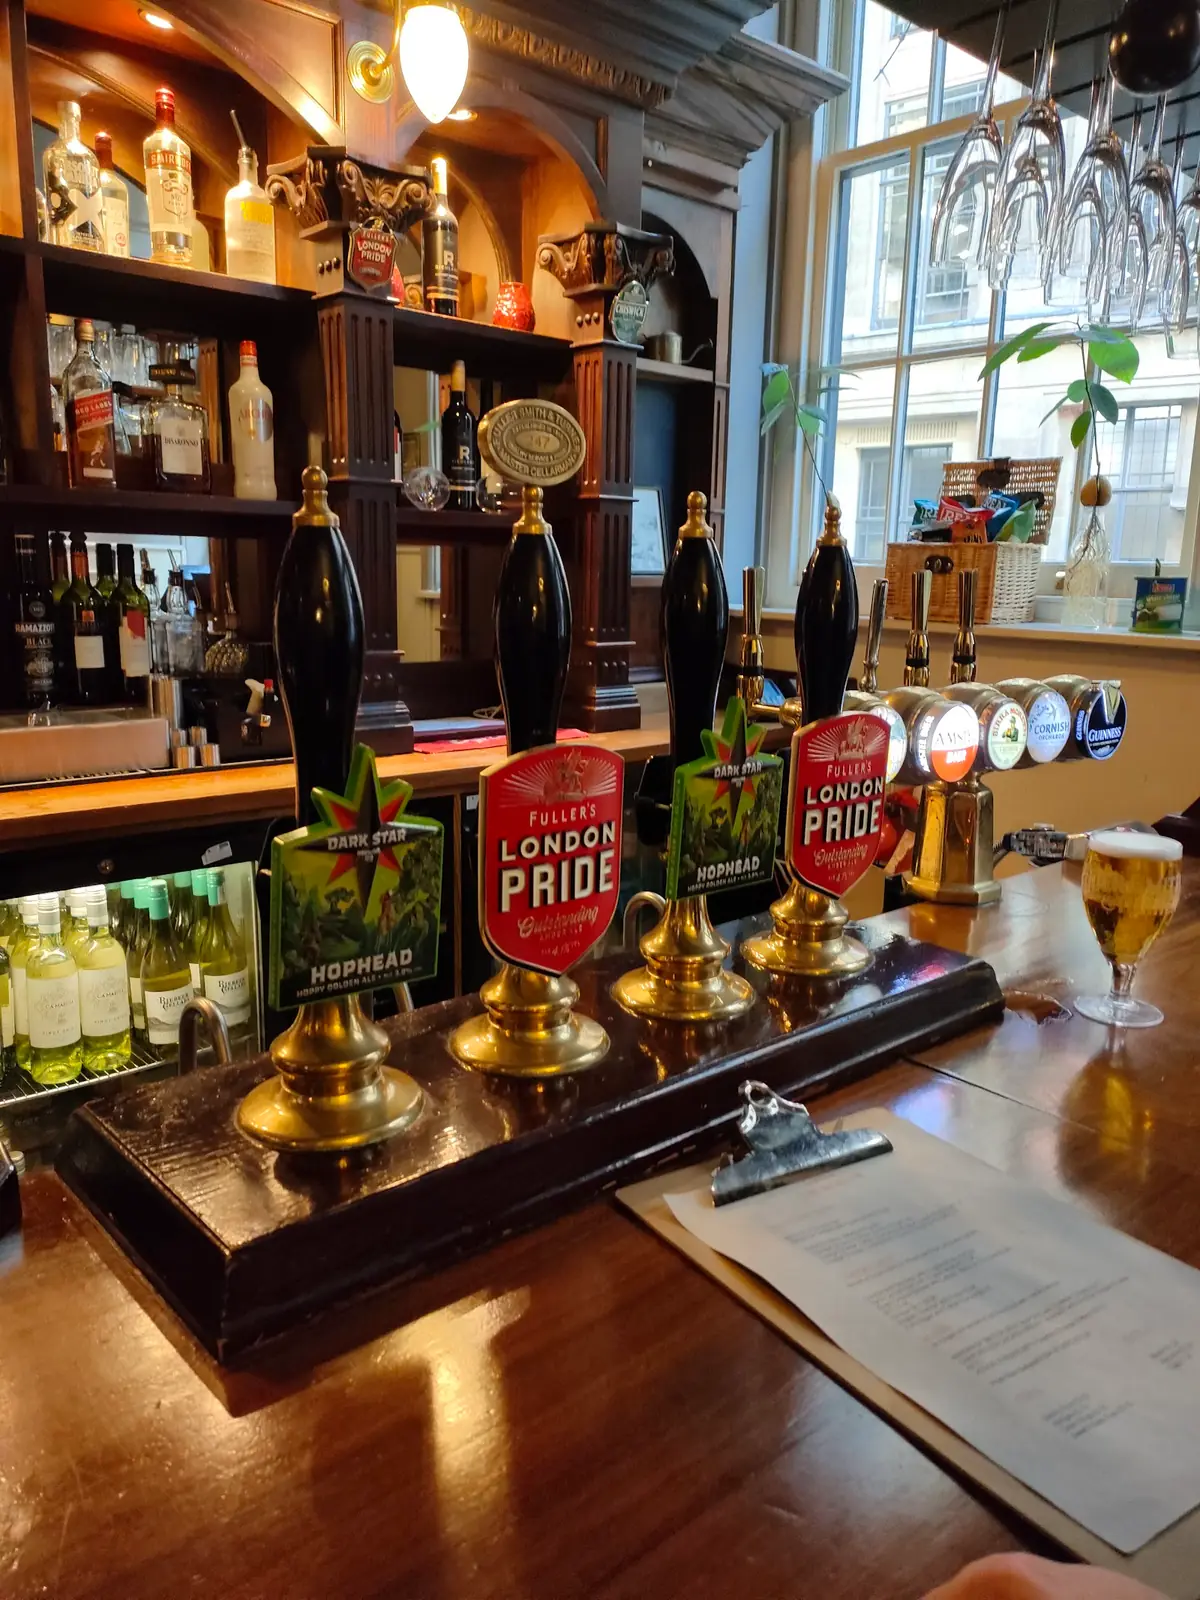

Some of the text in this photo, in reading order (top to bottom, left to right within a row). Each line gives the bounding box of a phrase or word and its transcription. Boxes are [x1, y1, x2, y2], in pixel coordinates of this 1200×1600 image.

[357, 240, 392, 257] LONDON
[361, 250, 386, 263] PRIDE
[616, 303, 644, 317] CHISWICK
[520, 406, 546, 420] SMITH
[163, 436, 199, 447] DISARONNO
[459, 445, 470, 460] R
[530, 453, 577, 478] CELLARMAN
[1034, 721, 1070, 735] CORNISH
[1088, 726, 1122, 743] GUINNESS
[714, 760, 762, 778] DARK STAR
[827, 760, 872, 778] FULLER'S
[806, 776, 884, 805] LONDON
[529, 803, 596, 827] FULLER'S
[803, 800, 882, 846] PRIDE
[328, 828, 406, 851] DARK STAR
[500, 821, 616, 862] LONDON
[813, 842, 868, 867] Outstanding
[697, 855, 761, 882] HOPHEAD
[500, 849, 615, 913] PRIDE
[517, 904, 599, 939] Outstanding
[311, 948, 413, 985] HOPHEAD
[296, 985, 326, 998] HOPPY
[326, 978, 360, 992] GOLDEN
[362, 973, 377, 984] ALE
